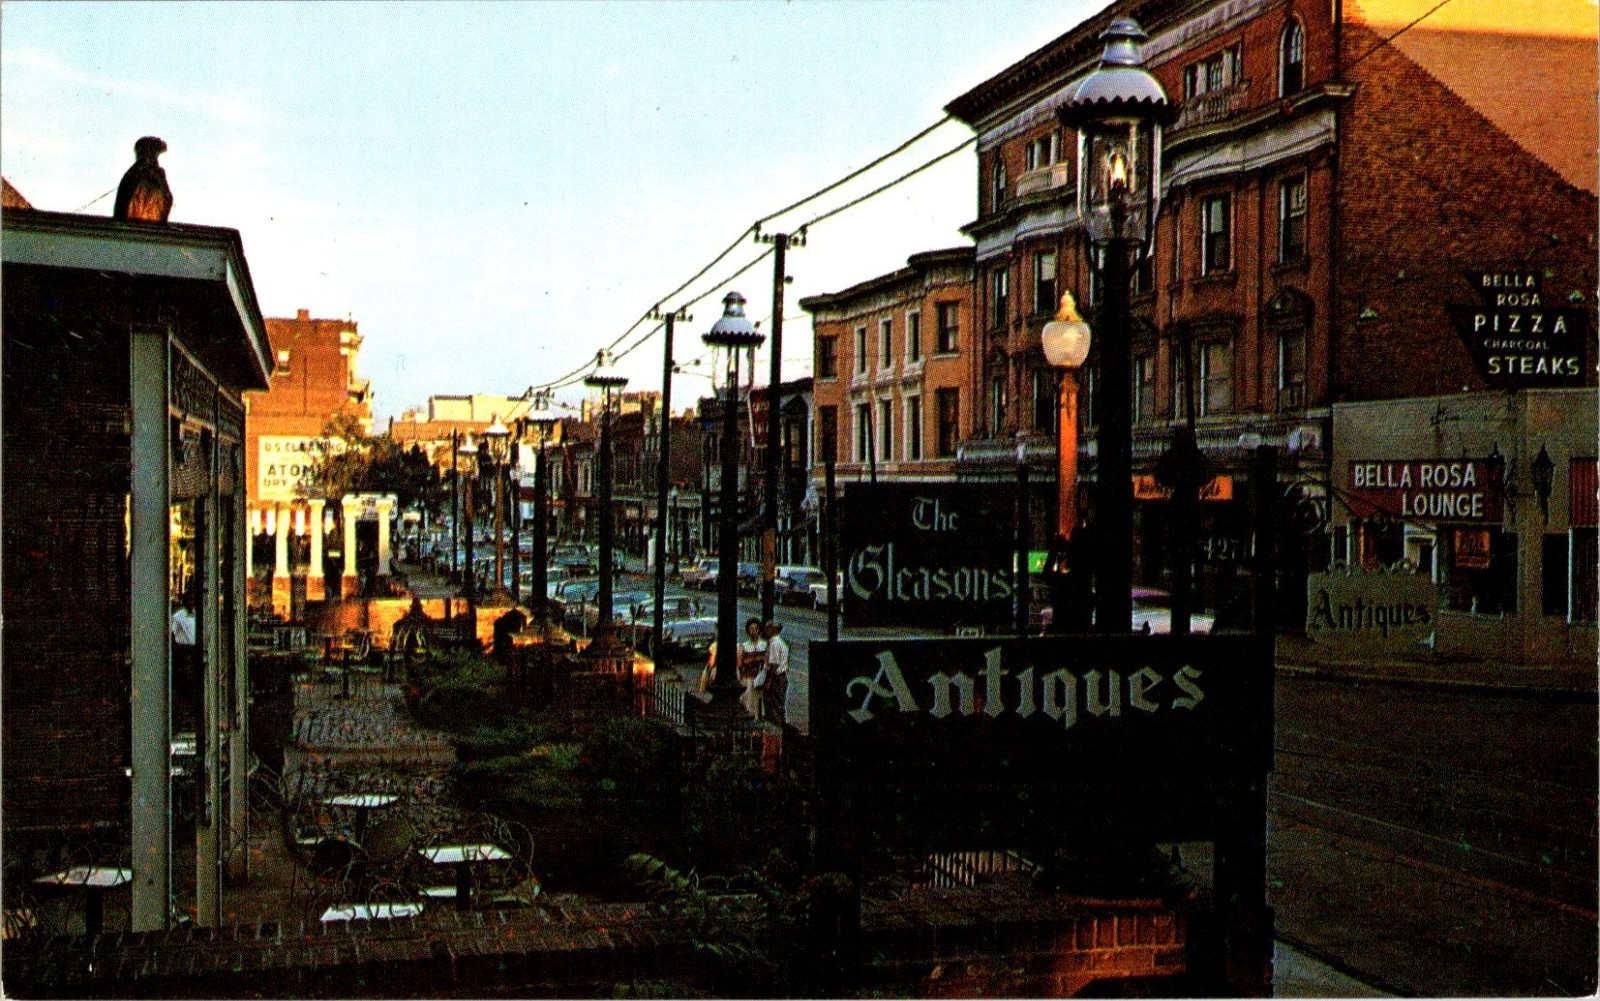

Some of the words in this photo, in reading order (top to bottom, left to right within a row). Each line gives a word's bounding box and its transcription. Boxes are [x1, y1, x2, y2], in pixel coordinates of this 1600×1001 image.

[1482, 273, 1535, 287] BELLA
[1497, 293, 1541, 306] ROSA
[1474, 314, 1567, 333] PIZZA
[1483, 339, 1549, 350] CHARCOAL
[1488, 356, 1580, 375] STEAKS
[1354, 463, 1412, 488] BELLA
[1420, 462, 1477, 488] ROSA
[911, 497, 960, 531] The
[1401, 493, 1484, 517] LOUNGE
[849, 542, 1012, 600] Gleasons
[1312, 587, 1432, 638] Antiques
[846, 646, 1205, 730] Antiques
